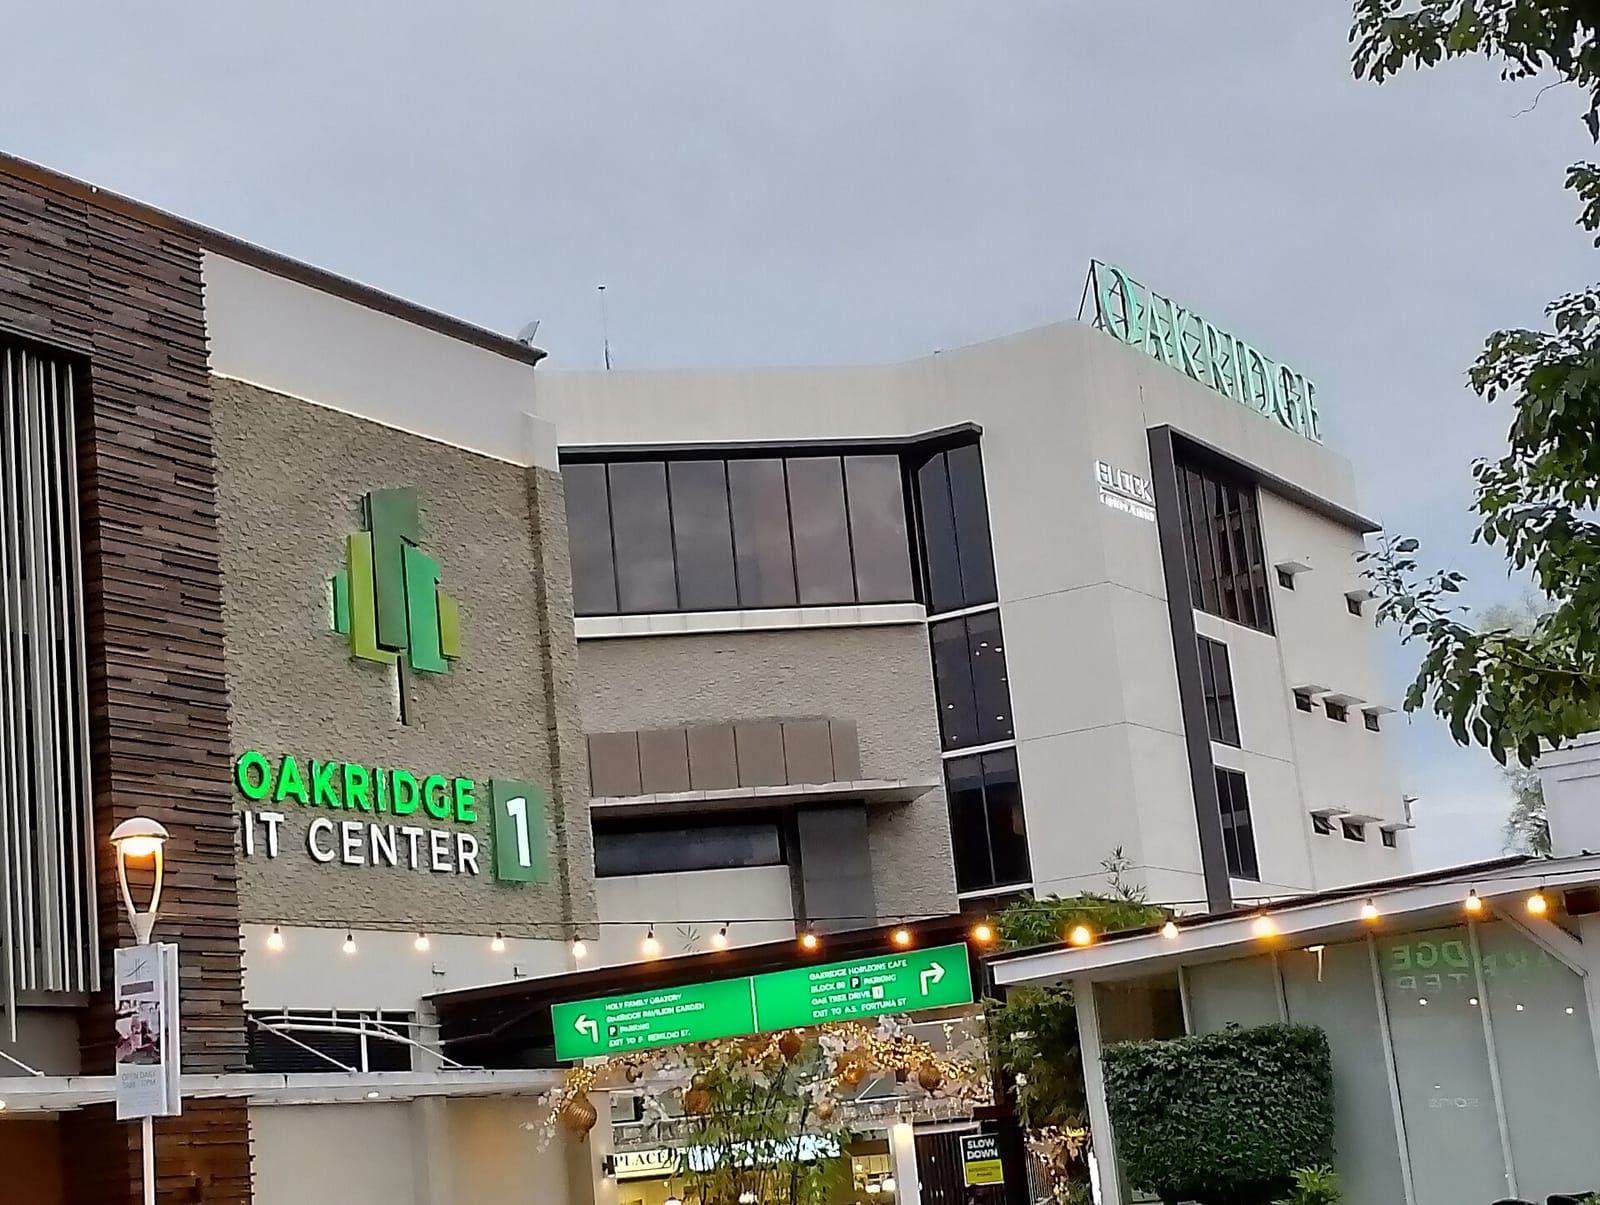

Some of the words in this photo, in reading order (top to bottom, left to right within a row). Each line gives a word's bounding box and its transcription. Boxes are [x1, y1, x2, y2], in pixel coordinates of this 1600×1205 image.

[1101, 265, 1323, 446] OAKRIDGE
[236, 750, 478, 823] OAKRIDGE
[505, 797, 531, 867] 1
[242, 810, 285, 858] IT
[307, 817, 480, 875] CENTER
[810, 984, 835, 993] BLOCK
[812, 1010, 828, 1018] EXIT
[830, 1008, 842, 1016] TO
[860, 1000, 896, 1011] FORTUNA
[608, 1039, 624, 1048] EXIT
[967, 1138, 994, 1149] SLOW
[967, 1148, 998, 1160] DOWN
